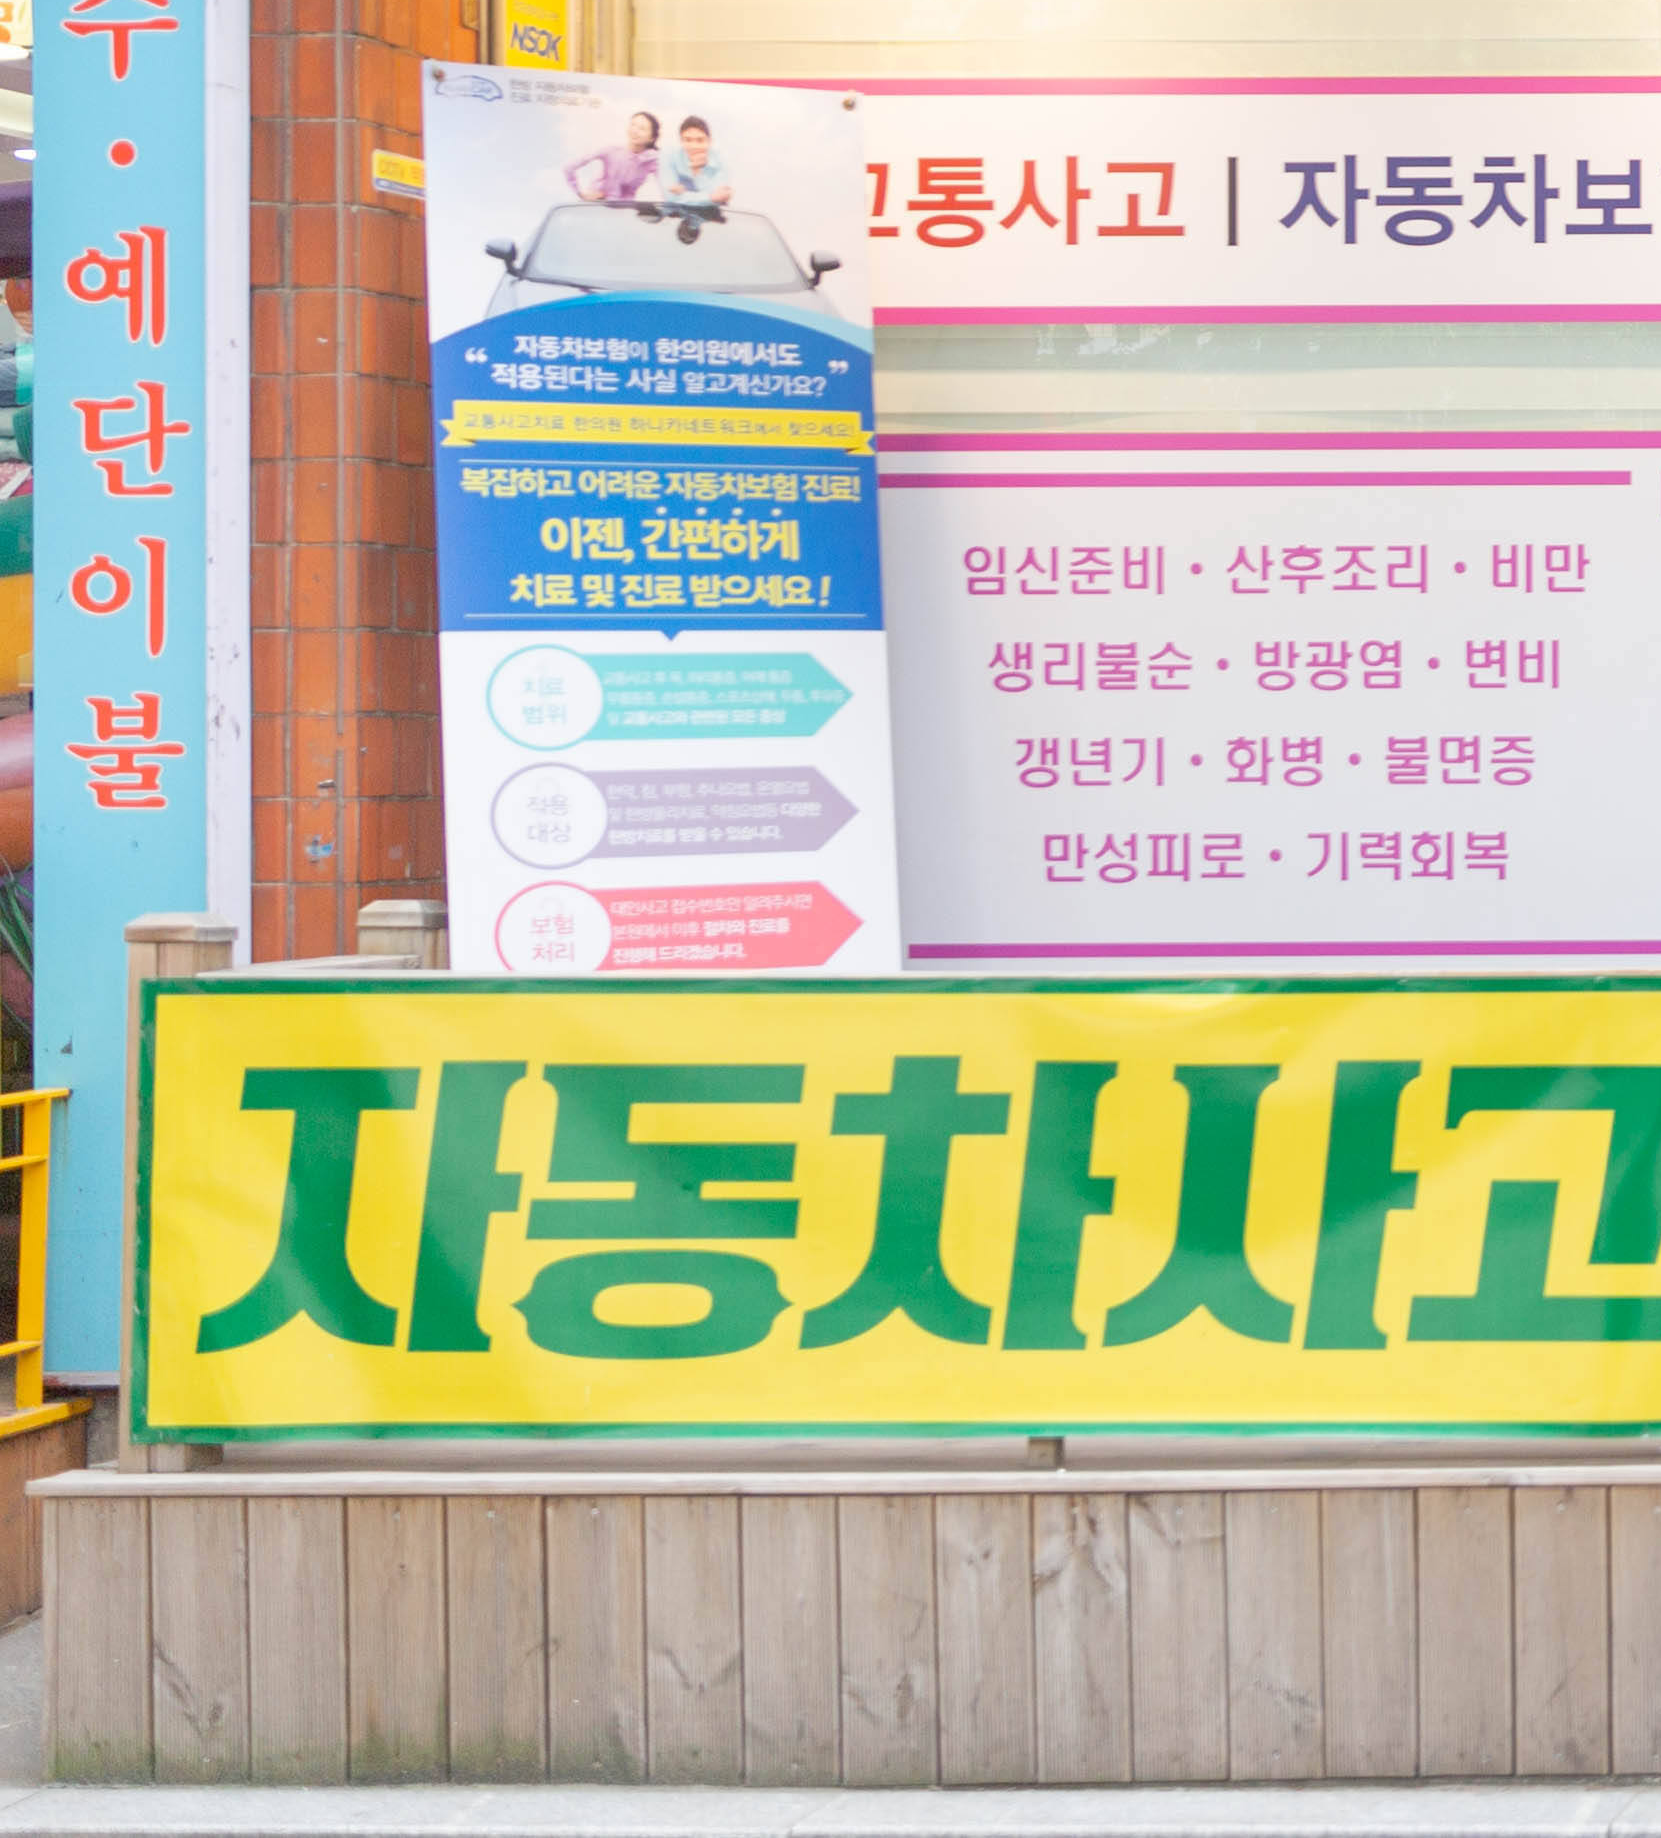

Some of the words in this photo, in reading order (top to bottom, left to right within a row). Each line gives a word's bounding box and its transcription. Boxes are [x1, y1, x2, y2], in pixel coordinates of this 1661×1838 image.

[655, 337, 802, 366] 한의원에서도
[491, 363, 620, 392] 적용된다는
[626, 367, 676, 392] 사실
[460, 468, 574, 498] 복잡하고
[579, 471, 661, 498] 어려운
[666, 473, 798, 501] 자동차보험
[541, 518, 635, 563] 이젠,
[643, 518, 800, 563] 간편하게
[510, 574, 576, 607] 치료
[583, 574, 613, 607] 및
[622, 575, 685, 607] 진료
[963, 543, 1167, 597] 임신준비
[1225, 543, 1432, 597] 산후조리
[1489, 542, 1591, 596] 비만
[987, 639, 1194, 694] 생리불순
[1252, 639, 1405, 693] 방광염
[1464, 638, 1563, 691] 변비
[1014, 735, 1168, 790] 갱년기
[1225, 735, 1325, 789] 화병
[1384, 734, 1537, 788] 불면증
[1042, 830, 1248, 885] 만성피로
[1305, 829, 1511, 883] 기력회복
